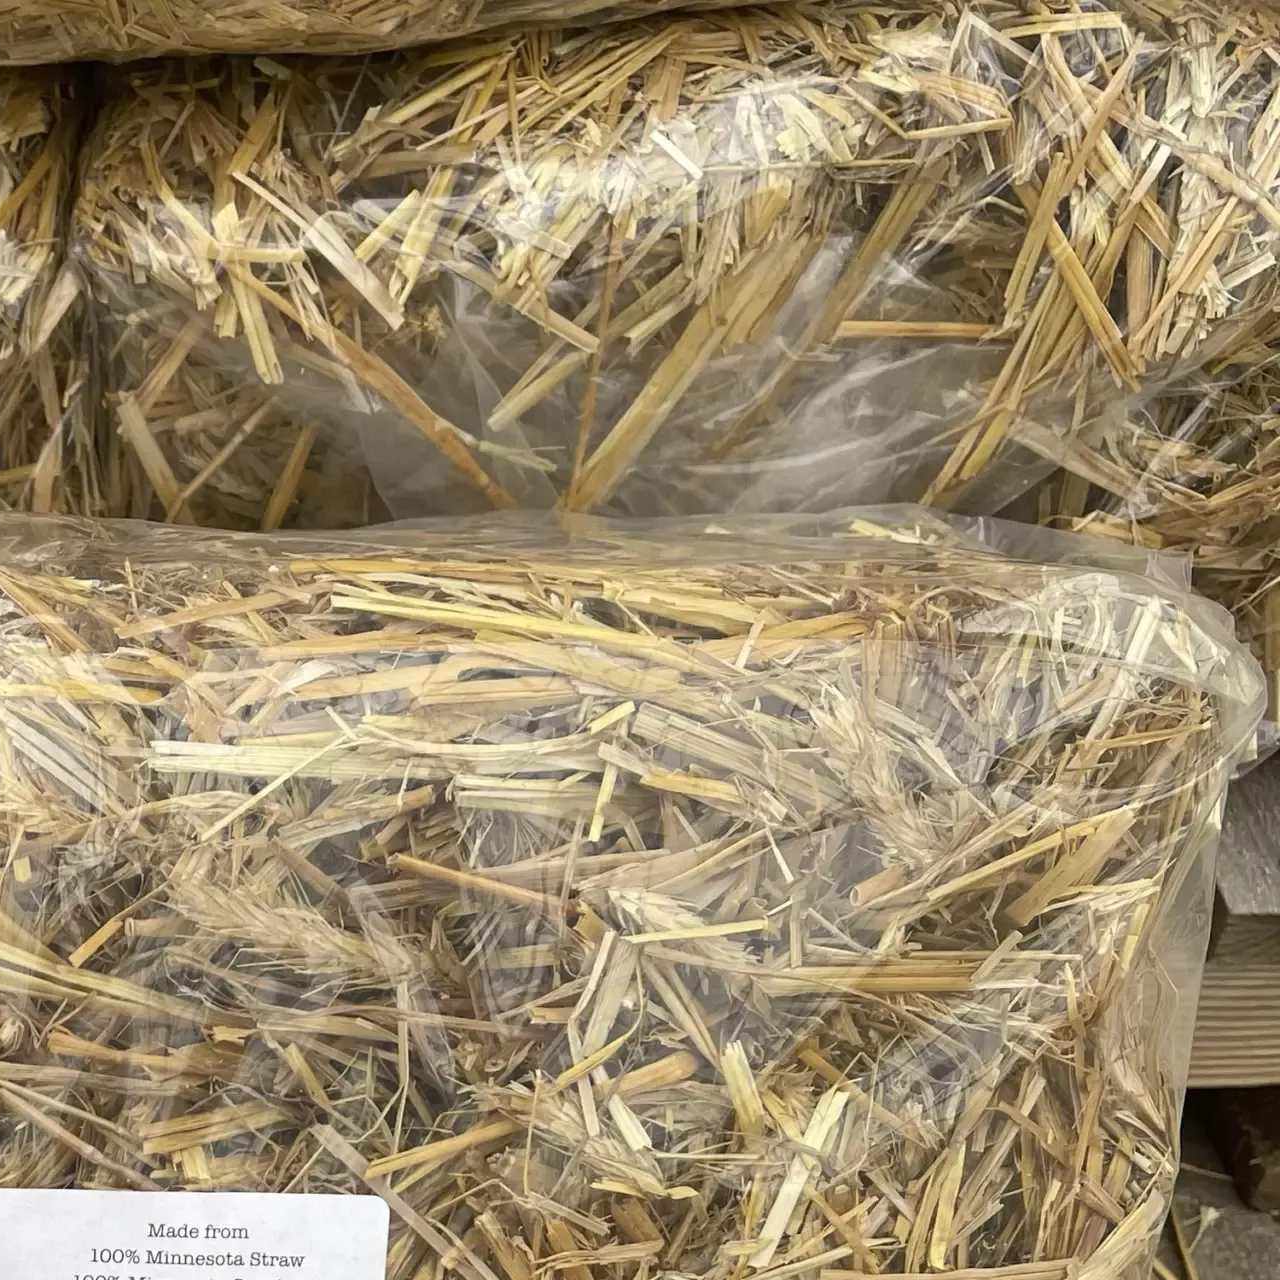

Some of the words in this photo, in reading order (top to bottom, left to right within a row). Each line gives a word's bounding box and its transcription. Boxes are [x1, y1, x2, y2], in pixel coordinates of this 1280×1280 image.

[148, 1223, 200, 1239] Made
[204, 1224, 250, 1240] from
[90, 1248, 140, 1265] 100%
[144, 1250, 245, 1267] Minnesota
[249, 1252, 306, 1268] Straw
